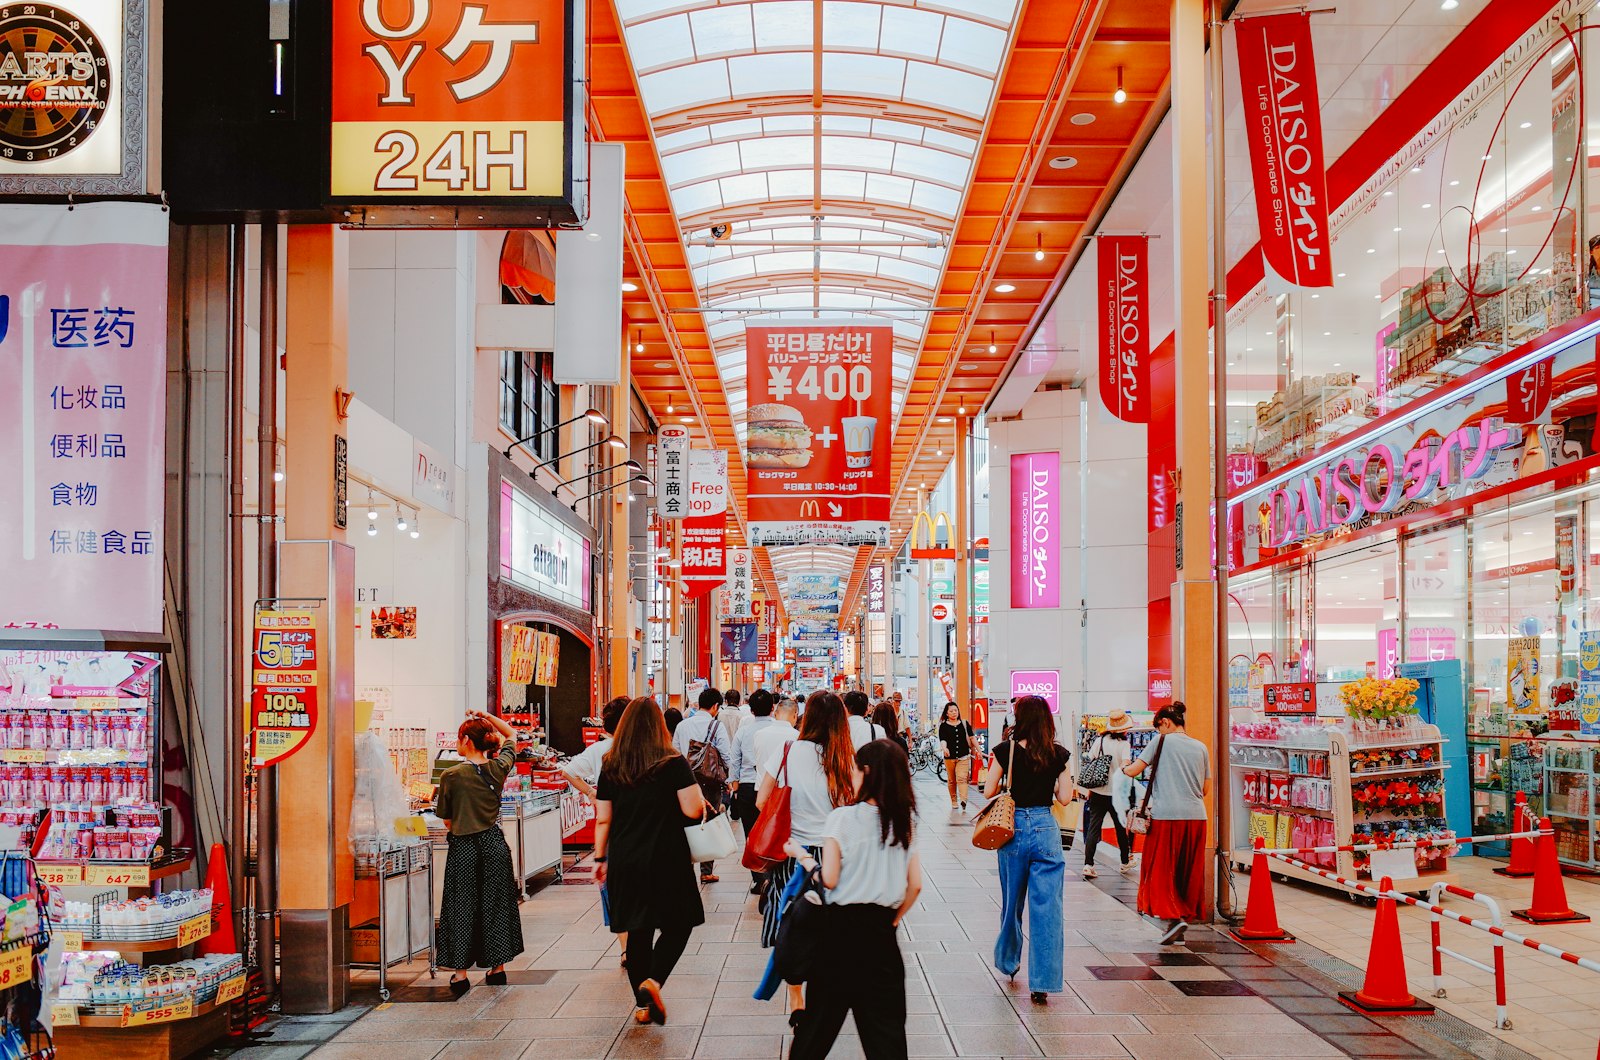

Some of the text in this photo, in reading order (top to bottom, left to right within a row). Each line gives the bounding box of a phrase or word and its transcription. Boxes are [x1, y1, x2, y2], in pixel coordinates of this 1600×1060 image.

[2, 9, 9, 18] 5
[24, 6, 36, 15] 20
[50, 9, 55, 18] 1
[69, 20, 80, 30] 18
[86, 37, 93, 46] 4
[436, 3, 539, 104] ケ
[95, 57, 106, 66] 13
[99, 79, 107, 88] 6
[95, 100, 106, 110] 10
[1270, 41, 1312, 175] DAISO
[85, 121, 96, 130] 15
[69, 137, 77, 146] 2
[3, 148, 13, 157] 19
[26, 151, 34, 160] 3
[48, 148, 58, 157] 17
[373, 129, 527, 192] 24H
[1257, 85, 1284, 237] Life Coordinate Shop
[1289, 181, 1321, 271] ダイソー
[1120, 253, 1139, 345] DAISO
[50, 306, 136, 348] 医药
[1108, 301, 1116, 356] Coordinate
[768, 352, 872, 364] バリューランチ コンビ
[768, 365, 872, 401] ¥400
[1121, 349, 1138, 411] ダイソー
[50, 385, 126, 410] 化妆品
[50, 433, 126, 459] 便利品
[666, 450, 682, 513] 富士商会
[692, 481, 723, 494] Free
[783, 482, 812, 491] 平日限定
[1268, 443, 1400, 548] DAISO
[1402, 417, 1514, 500] ダイソー
[50, 482, 97, 507] 食物
[1032, 469, 1049, 543] DAISO
[50, 530, 155, 556] 保健食品
[1032, 546, 1049, 597] ダイソー
[734, 569, 746, 615] 磯丸水産
[869, 567, 884, 611] 星乃珈琲
[282, 633, 312, 642] ポイント
[1522, 638, 1540, 650] 2018
[798, 648, 828, 656] スロット
[1017, 682, 1054, 692] DAISO
[264, 694, 305, 711] 100円
[106, 874, 131, 884] 647
[189, 928, 202, 940] 276
[146, 1009, 173, 1021] 555
